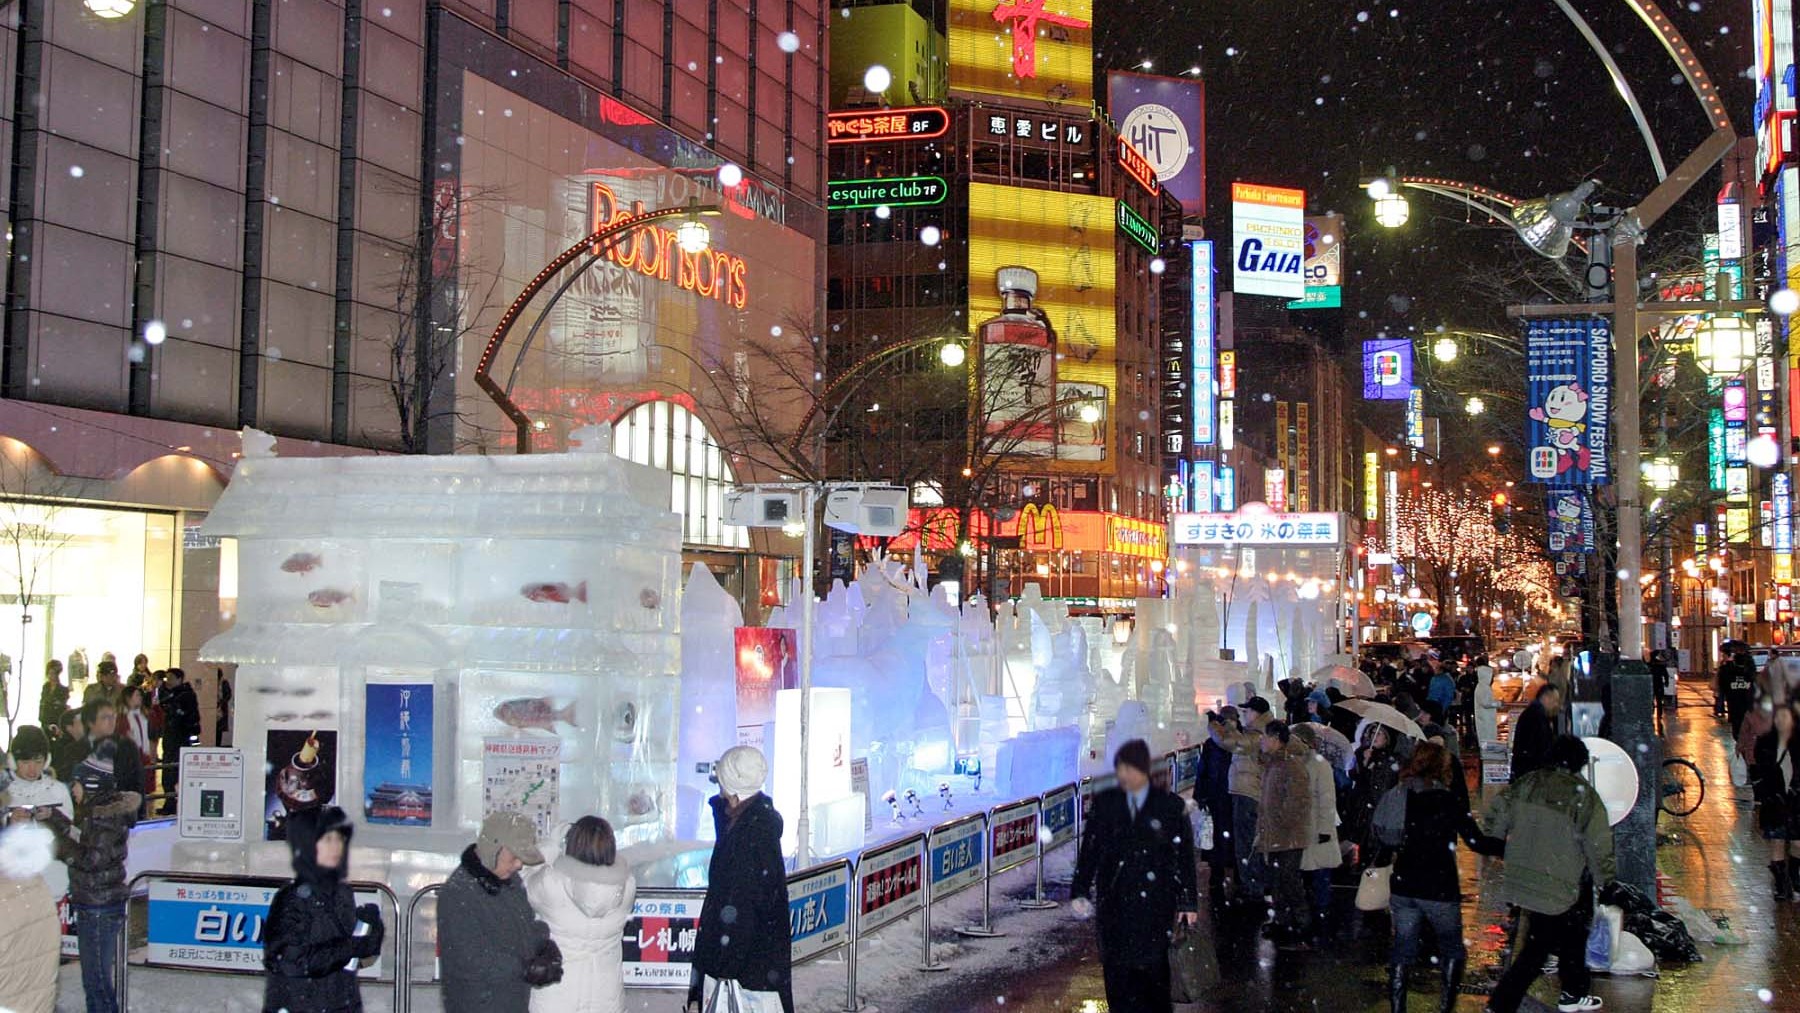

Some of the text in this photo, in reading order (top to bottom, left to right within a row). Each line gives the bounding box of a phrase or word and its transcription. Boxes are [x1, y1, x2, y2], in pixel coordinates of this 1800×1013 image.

[912, 121, 929, 132] 8F
[832, 182, 937, 204] esquire club 7F
[1590, 328, 1608, 479] SAPPORO SNOW FESTIVAL
[1187, 522, 1332, 540] すすきの 氷の祭典
